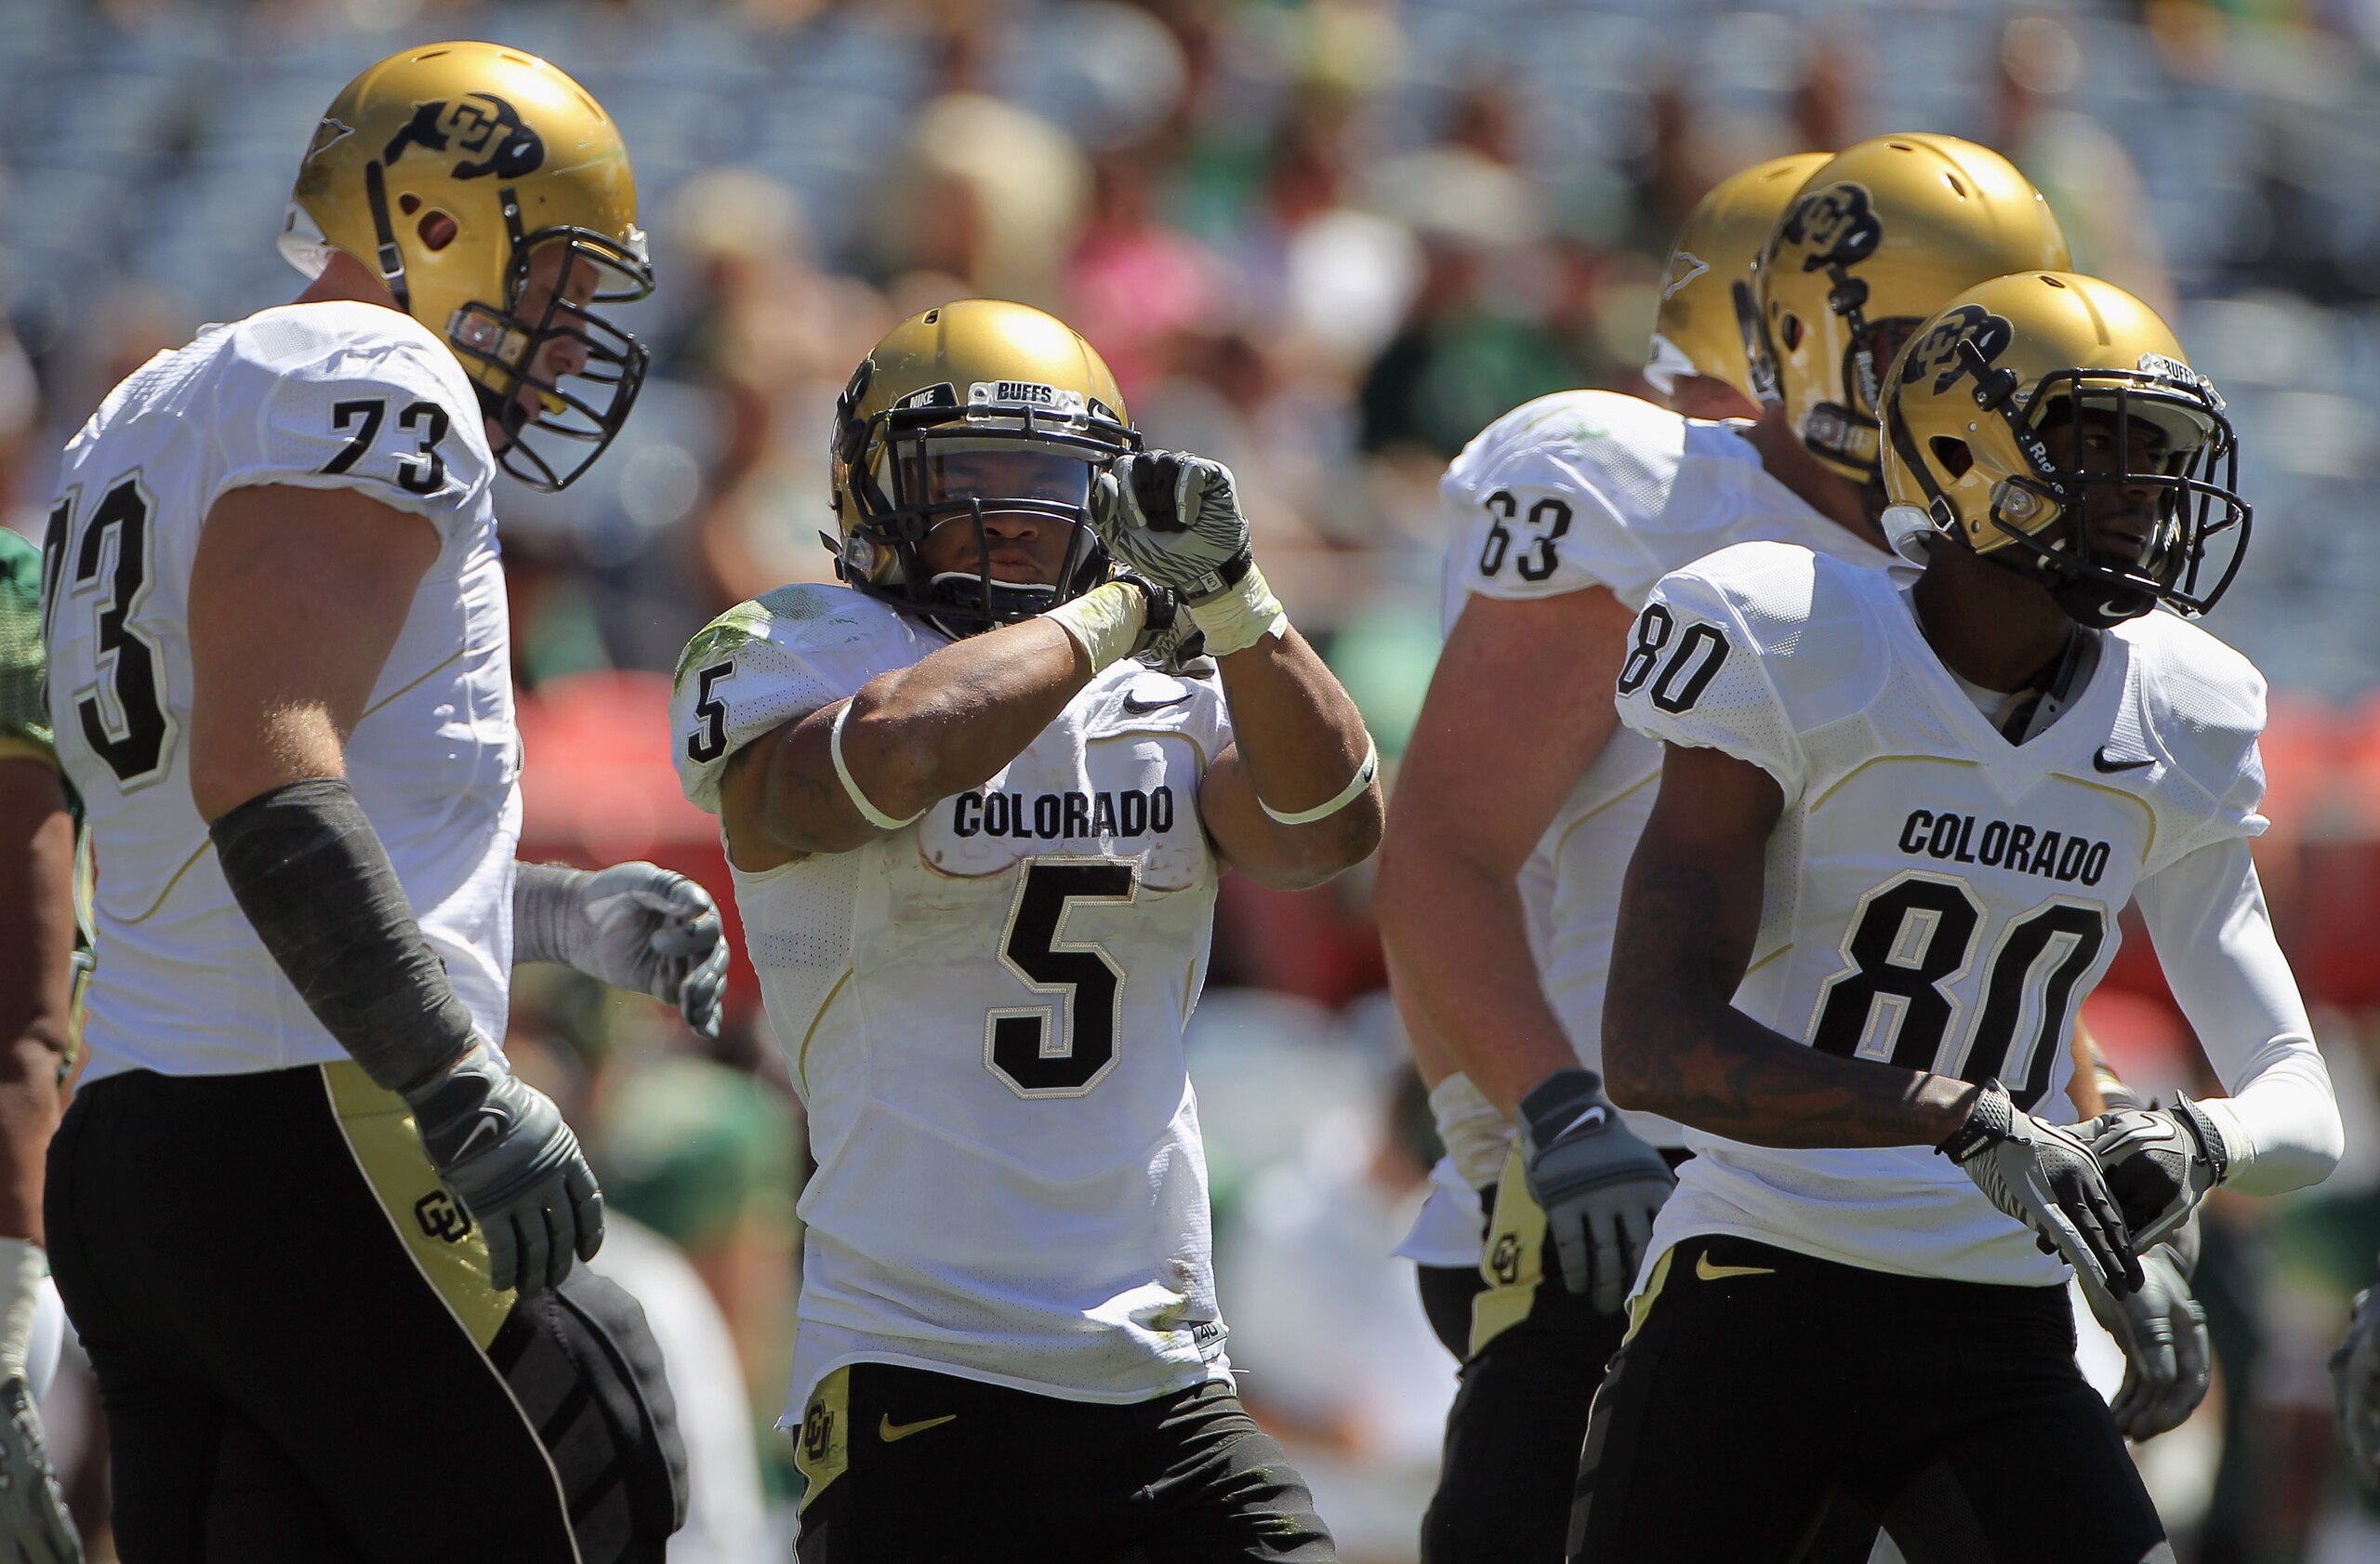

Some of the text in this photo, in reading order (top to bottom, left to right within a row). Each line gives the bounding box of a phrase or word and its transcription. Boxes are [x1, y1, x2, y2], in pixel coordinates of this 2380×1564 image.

[909, 389, 935, 409] NIKE
[998, 382, 1052, 403] BUFFS
[319, 398, 450, 495] 73
[1480, 490, 1574, 582] 63
[43, 470, 175, 790] 73
[1616, 603, 1732, 714] 80
[687, 658, 734, 763] 5
[954, 787, 1172, 838] COLORADO
[1898, 809, 2110, 886] COLORADO
[986, 858, 1139, 1097] 5
[1806, 872, 2107, 1112] 80
